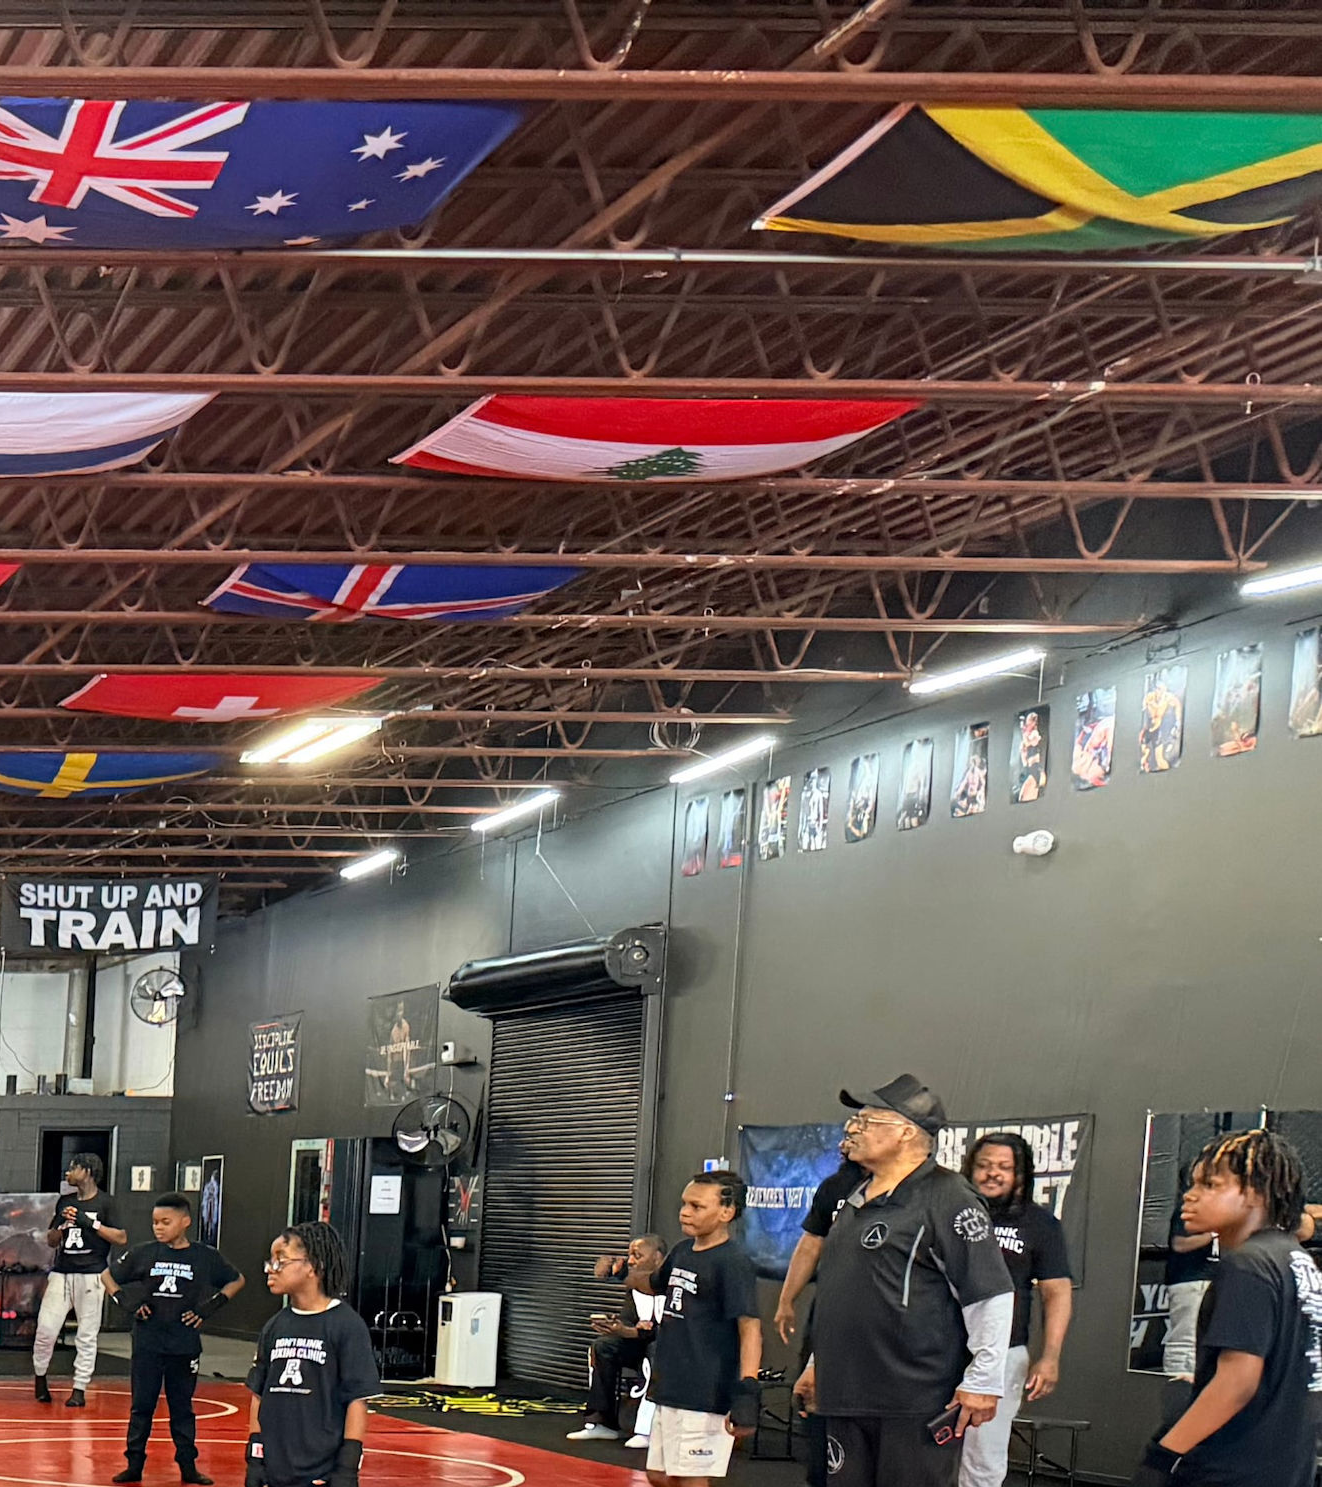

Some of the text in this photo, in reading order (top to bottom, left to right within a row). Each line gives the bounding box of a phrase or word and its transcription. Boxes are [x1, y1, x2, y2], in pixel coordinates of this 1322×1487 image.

[19, 882, 203, 909] SHUT UP AND
[19, 906, 201, 950] TRAIN
[252, 1048, 295, 1077] EQUALS
[250, 1077, 295, 1102] FREEDOM
[994, 1226, 1019, 1239] INK
[297, 1347, 327, 1365] CLINIC
